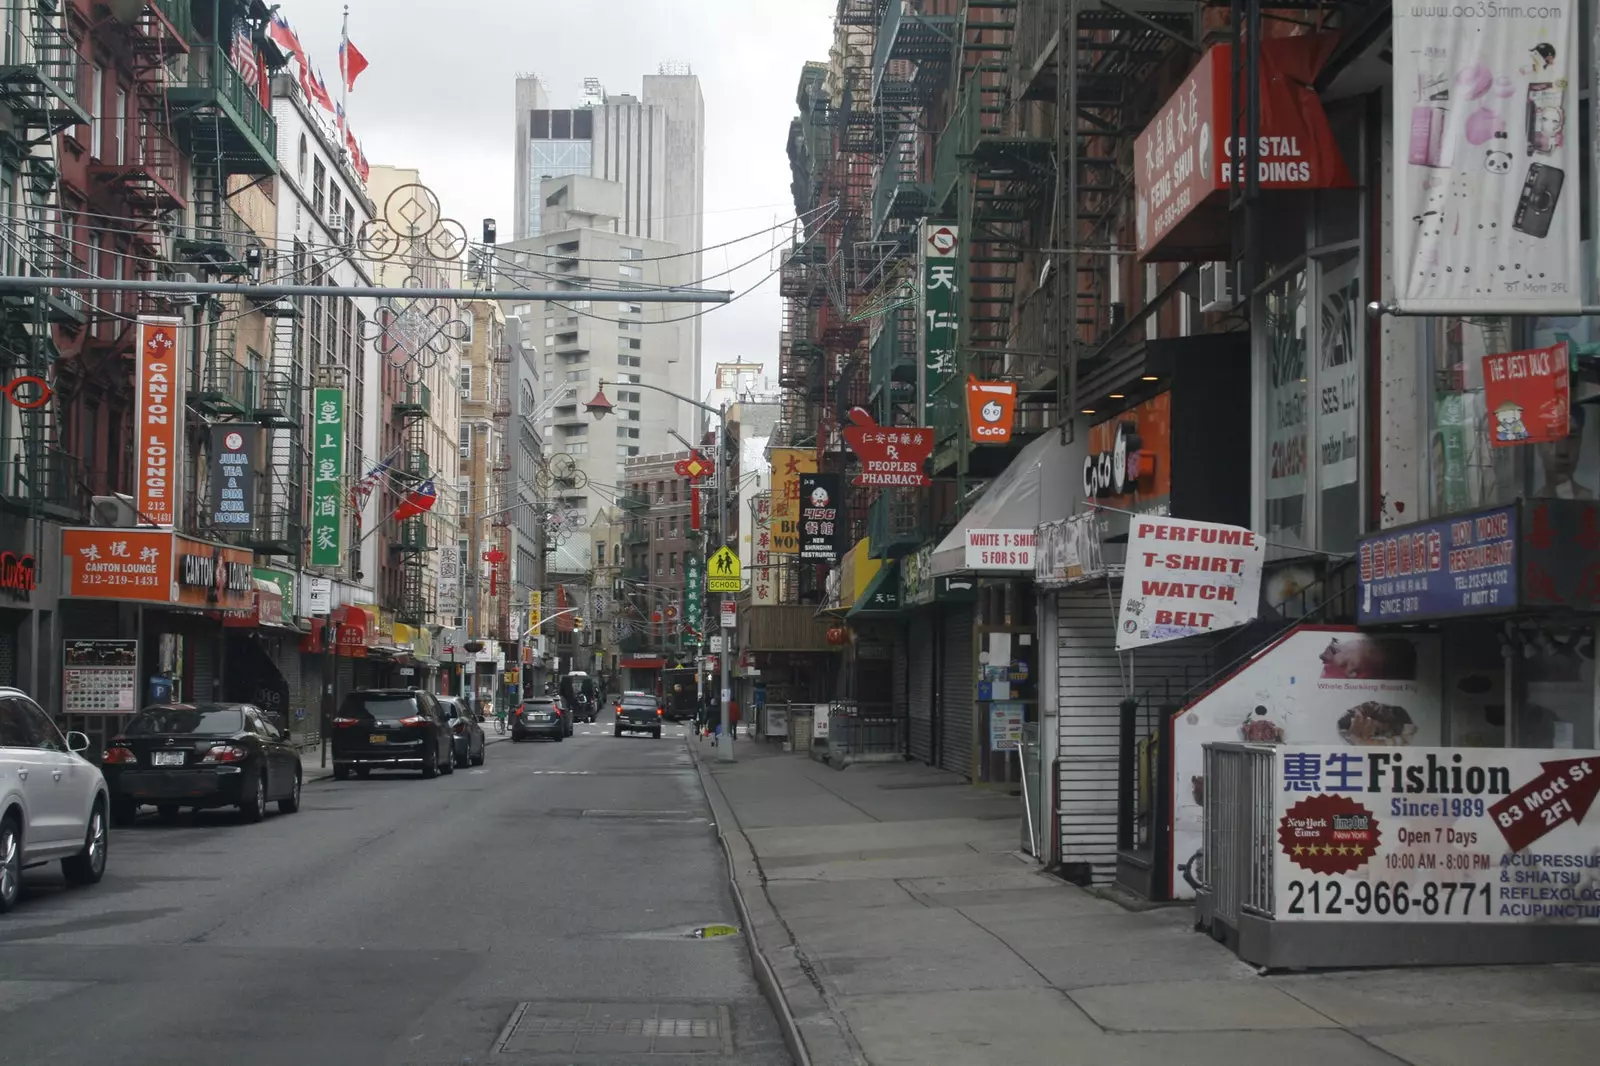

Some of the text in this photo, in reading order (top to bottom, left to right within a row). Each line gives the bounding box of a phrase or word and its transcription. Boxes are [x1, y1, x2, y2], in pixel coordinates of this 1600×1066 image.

[1224, 135, 1301, 157] CRSTAL
[1151, 145, 1194, 213] FENG SHUI
[1221, 161, 1311, 183] REDINGS
[1488, 357, 1506, 382] THE
[1507, 354, 1527, 380] BEST
[148, 363, 168, 424] CANTON
[862, 432, 924, 446] 仁安西藥房
[219, 453, 248, 465] JULIA
[146, 436, 167, 498] LOUNGE
[223, 466, 243, 476] TEA
[868, 461, 917, 472] PEOPLES
[228, 478, 237, 488] &
[862, 473, 923, 485] PHARMACY
[222, 488, 243, 499] DIM
[148, 502, 166, 511] 212
[220, 500, 244, 511] SUM
[214, 512, 250, 523] HOUSE
[803, 508, 836, 520] 456
[781, 520, 800, 532] BI
[805, 521, 834, 535] 餐館
[1475, 512, 1508, 542] WONG
[970, 533, 1000, 547] WHITE
[1137, 523, 1256, 547] PERFUME
[80, 541, 159, 564] 味悅軒
[982, 551, 1029, 565] 5 FOR $ 10
[1448, 540, 1513, 574] RESTAURANT
[85, 562, 157, 573] CANTON LOUNGE
[1142, 552, 1244, 573] T-SHIRT
[185, 554, 214, 587] CANTON
[229, 562, 252, 591] LOUNGE
[82, 574, 159, 586] 212-219-1431
[711, 581, 738, 589] SCHOOL
[1141, 580, 1236, 601] WATCH
[1380, 598, 1400, 614] SINCE
[1155, 609, 1214, 628] BELT
[1344, 683, 1378, 692] Suckling
[1283, 752, 1512, 795] 惠生 Fishion
[1498, 760, 1593, 828] 83 Mott St
[1391, 798, 1484, 817] Since1989
[1287, 818, 1328, 830] New York
[1294, 828, 1320, 838] Times
[1333, 831, 1368, 840] New York
[1398, 827, 1478, 848] Open 7 Days
[1386, 853, 1415, 869] 10:00
[1417, 853, 1436, 869] AM
[1446, 854, 1470, 870] 8:00
[1472, 854, 1490, 870] PM
[1499, 871, 1581, 884] & SHIATSU
[1287, 880, 1491, 916] 212-966-8771
